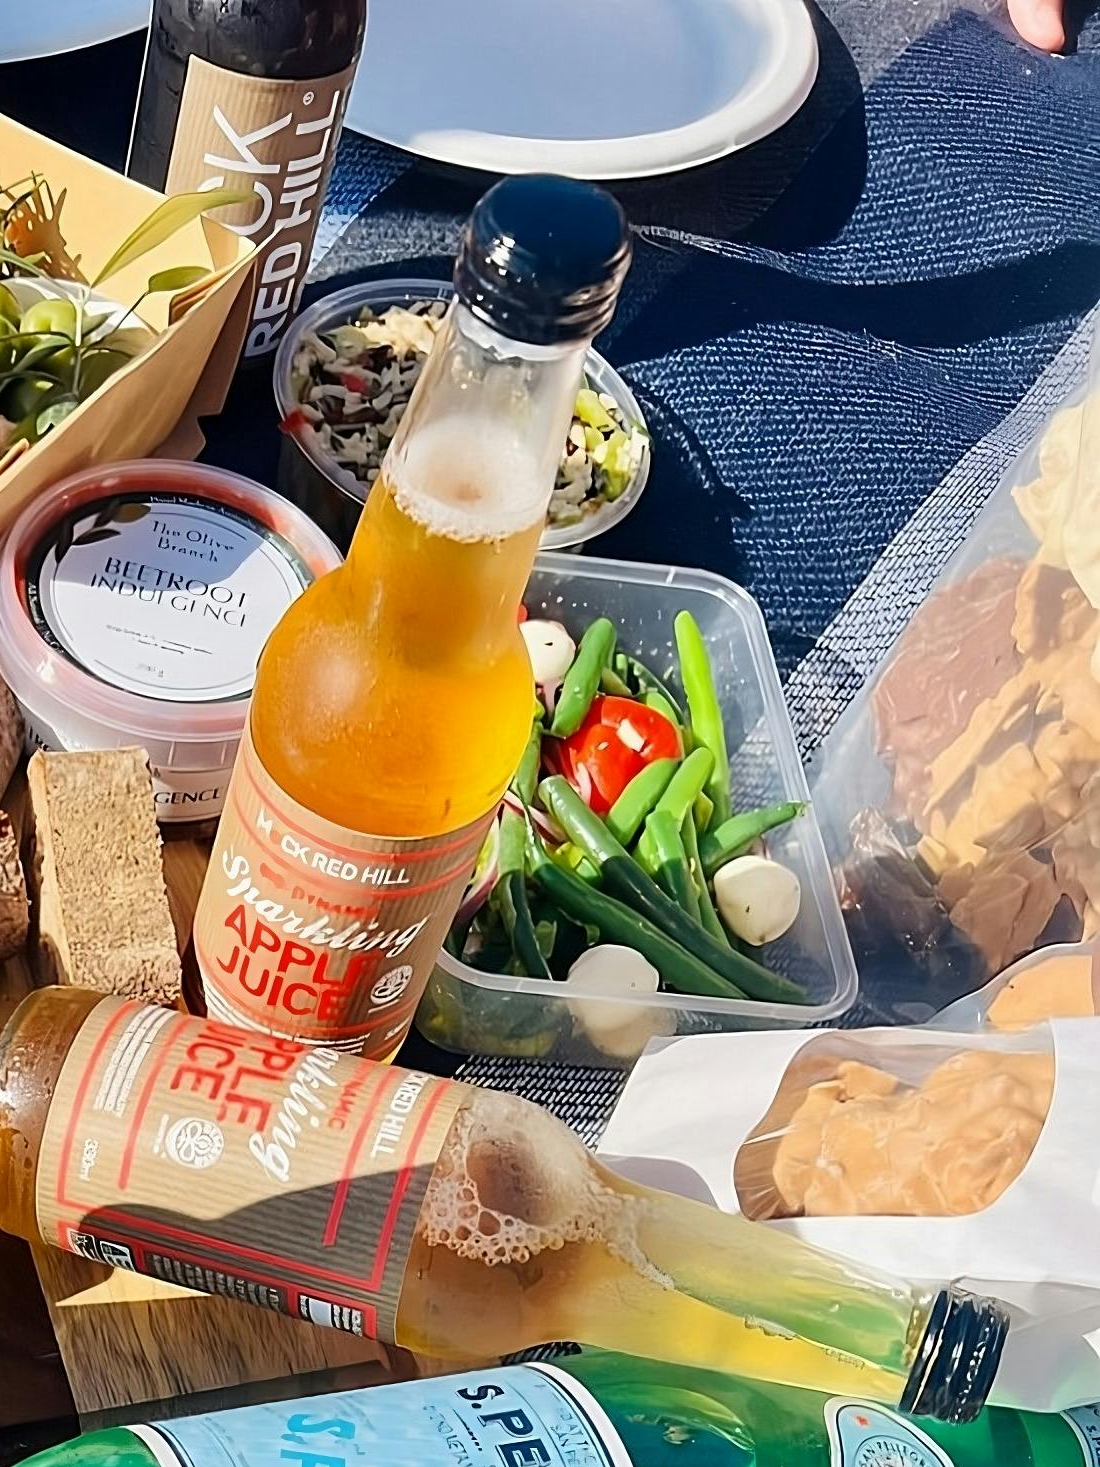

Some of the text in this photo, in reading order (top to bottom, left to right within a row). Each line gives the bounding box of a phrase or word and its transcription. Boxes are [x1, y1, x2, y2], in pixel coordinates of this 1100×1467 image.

[246, 90, 341, 357] RED HILL
[311, 851, 358, 881] RED
[361, 865, 410, 887] HILL
[222, 844, 432, 958] Sparkling
[216, 945, 347, 1022] JUICE
[390, 1081, 423, 1113] RED
[370, 1114, 407, 1159] HILL
